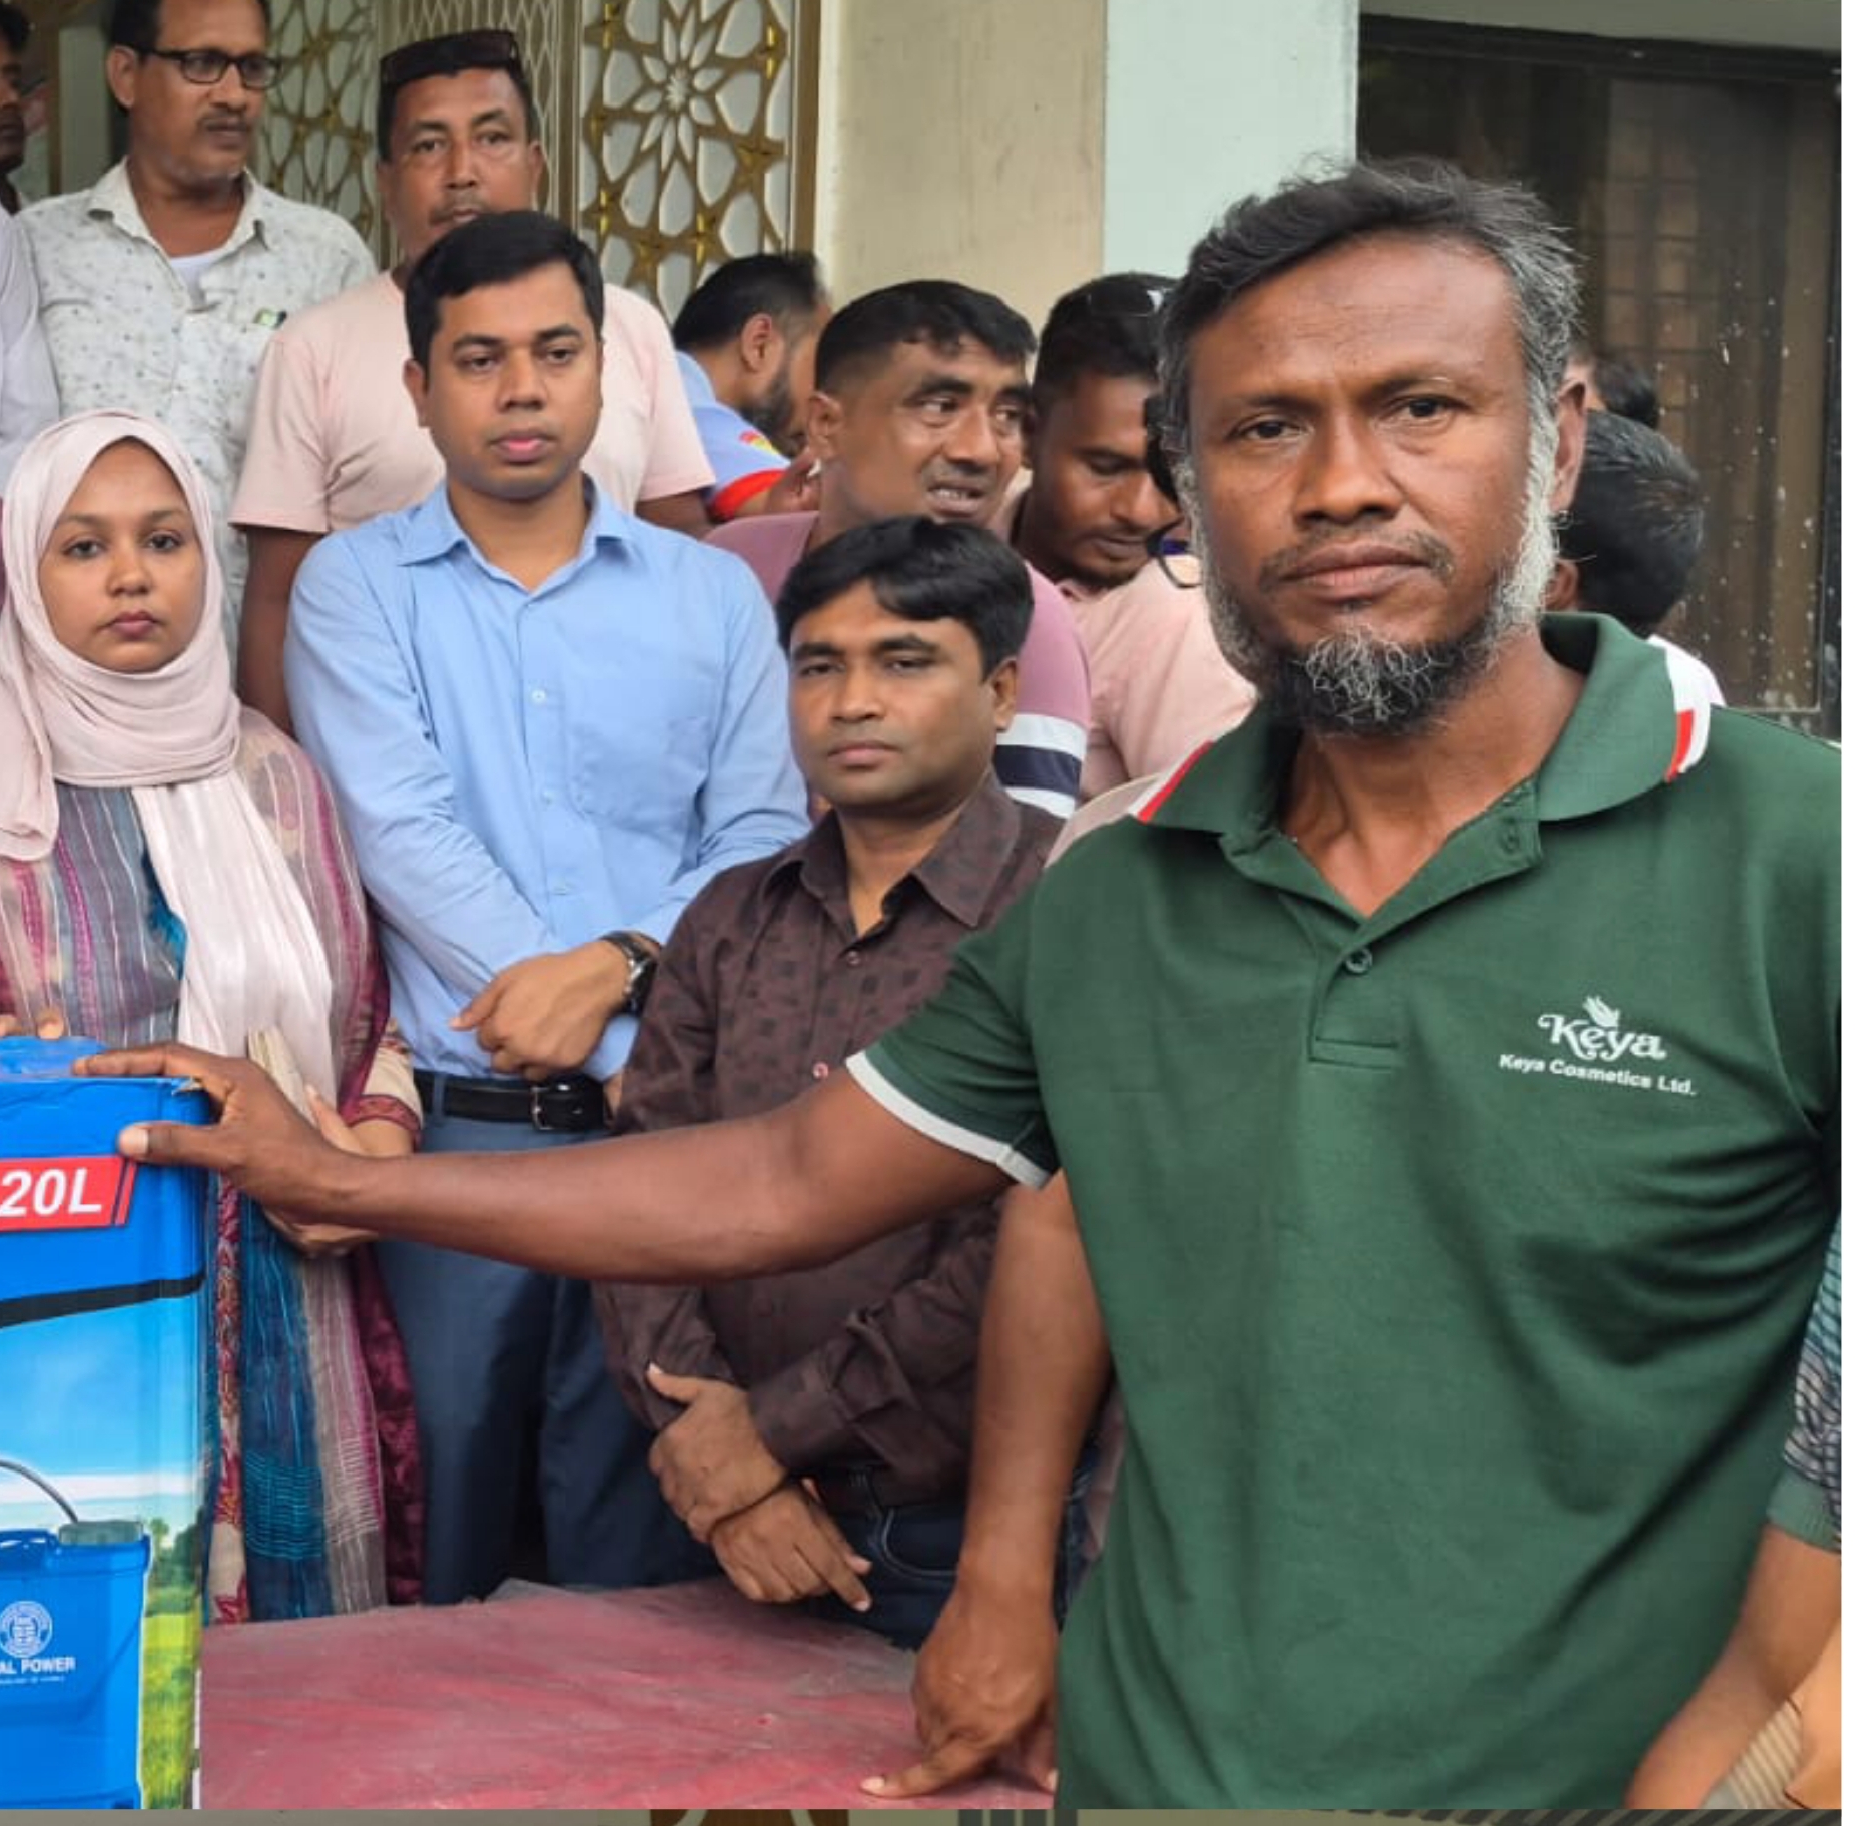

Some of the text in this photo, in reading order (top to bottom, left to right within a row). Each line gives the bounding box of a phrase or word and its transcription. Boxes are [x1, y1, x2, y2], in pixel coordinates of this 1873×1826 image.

[1538, 1013, 1668, 1061] Keya
[1499, 1053, 1698, 1097] Keya Cosmetics Ltd.
[21, 1657, 76, 1674] POWER
